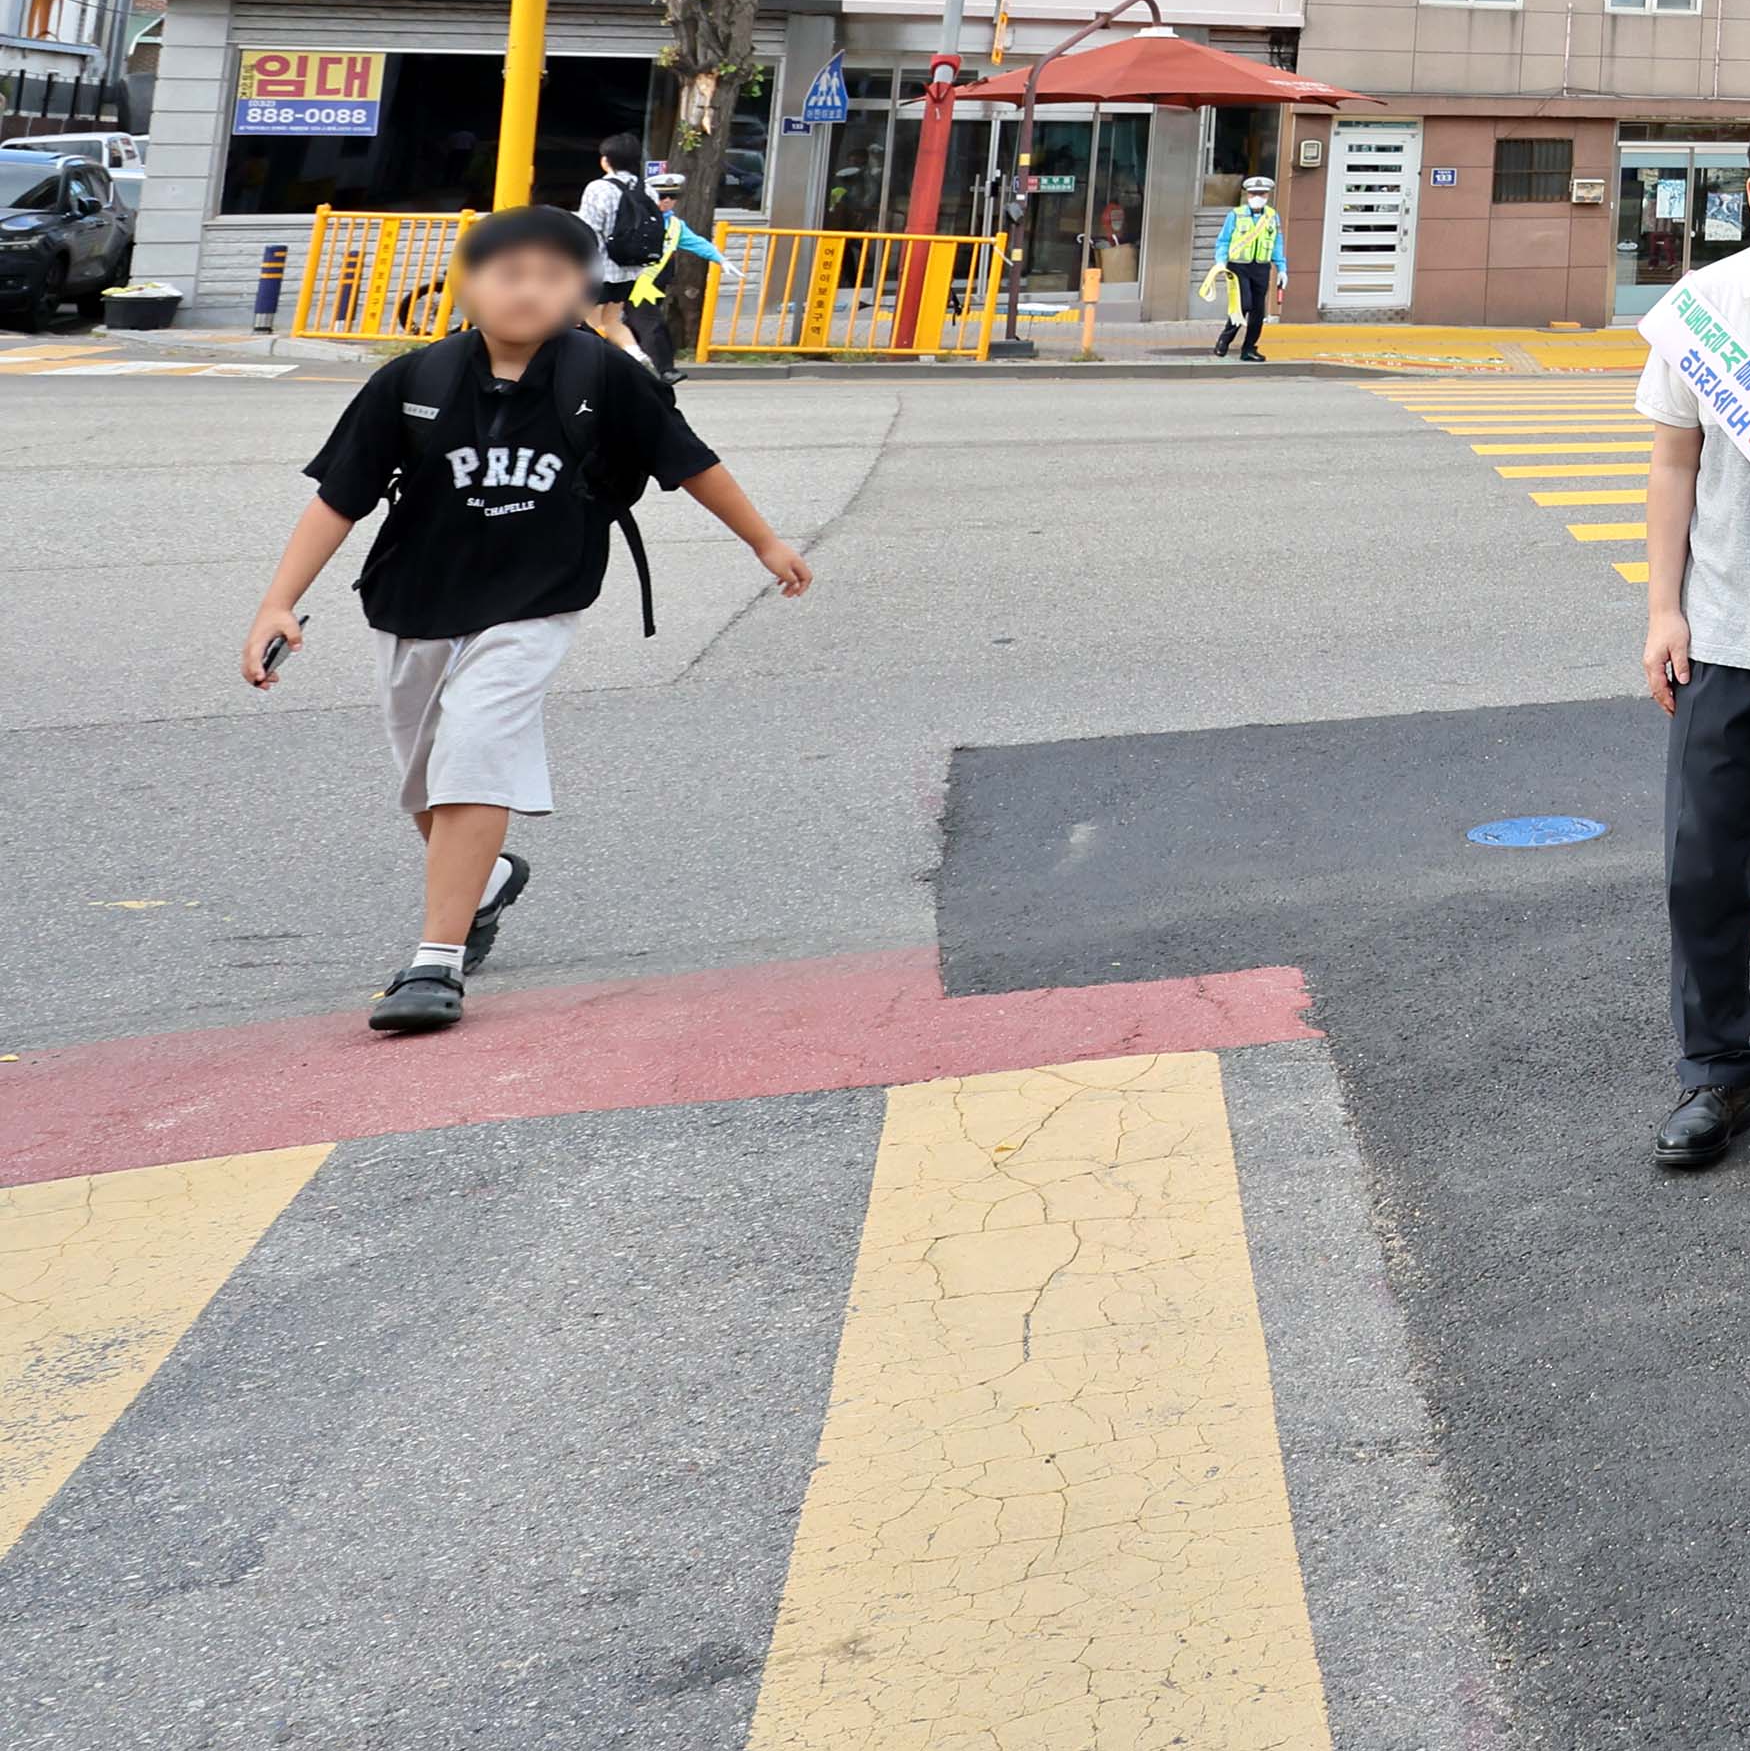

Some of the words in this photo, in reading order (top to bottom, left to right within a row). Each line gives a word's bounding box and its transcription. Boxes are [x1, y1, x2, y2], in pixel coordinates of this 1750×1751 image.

[255, 54, 372, 97] 임대
[246, 108, 367, 125] 888-0088
[811, 248, 834, 335] 어린이보호구역
[485, 499, 536, 517] CHAPELLE
